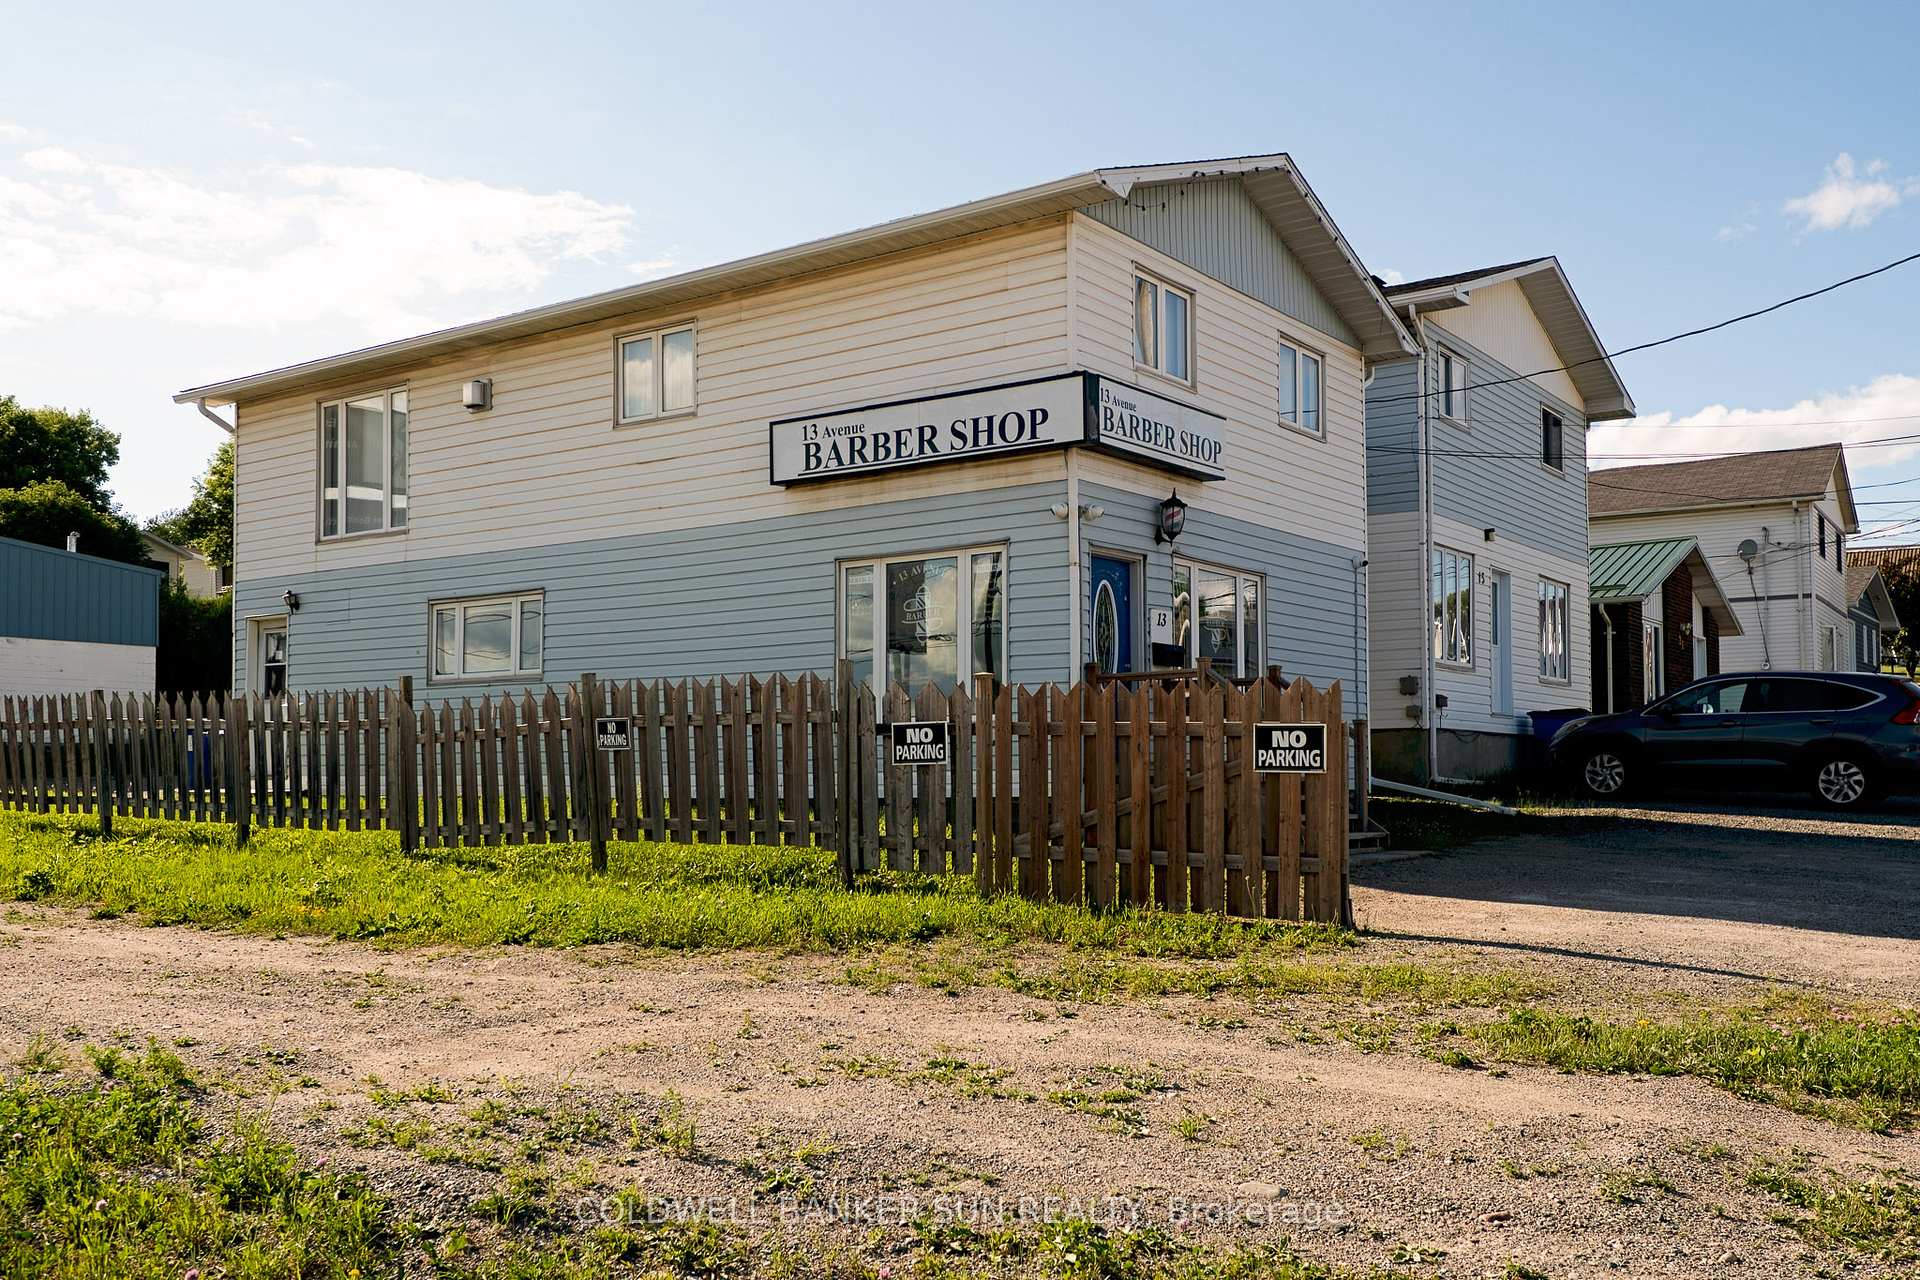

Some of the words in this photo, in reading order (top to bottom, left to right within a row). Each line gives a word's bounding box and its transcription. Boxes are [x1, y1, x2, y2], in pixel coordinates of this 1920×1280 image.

[1100, 387, 1110, 403] 13
[1111, 395, 1137, 412] Avenue
[802, 423, 818, 442] 13
[822, 423, 866, 439] Avenue
[802, 424, 942, 472] BARBER
[950, 407, 1049, 452] SHOP
[1103, 405, 1176, 452] BARBER
[1180, 430, 1222, 465] SHOP
[1156, 612, 1167, 627] 13
[607, 721, 617, 734] NO
[906, 727, 934, 744] NO
[599, 734, 627, 746] PARKING
[1271, 730, 1307, 748] NO
[896, 743, 944, 761] PARKING
[1257, 749, 1321, 767] PARKING
